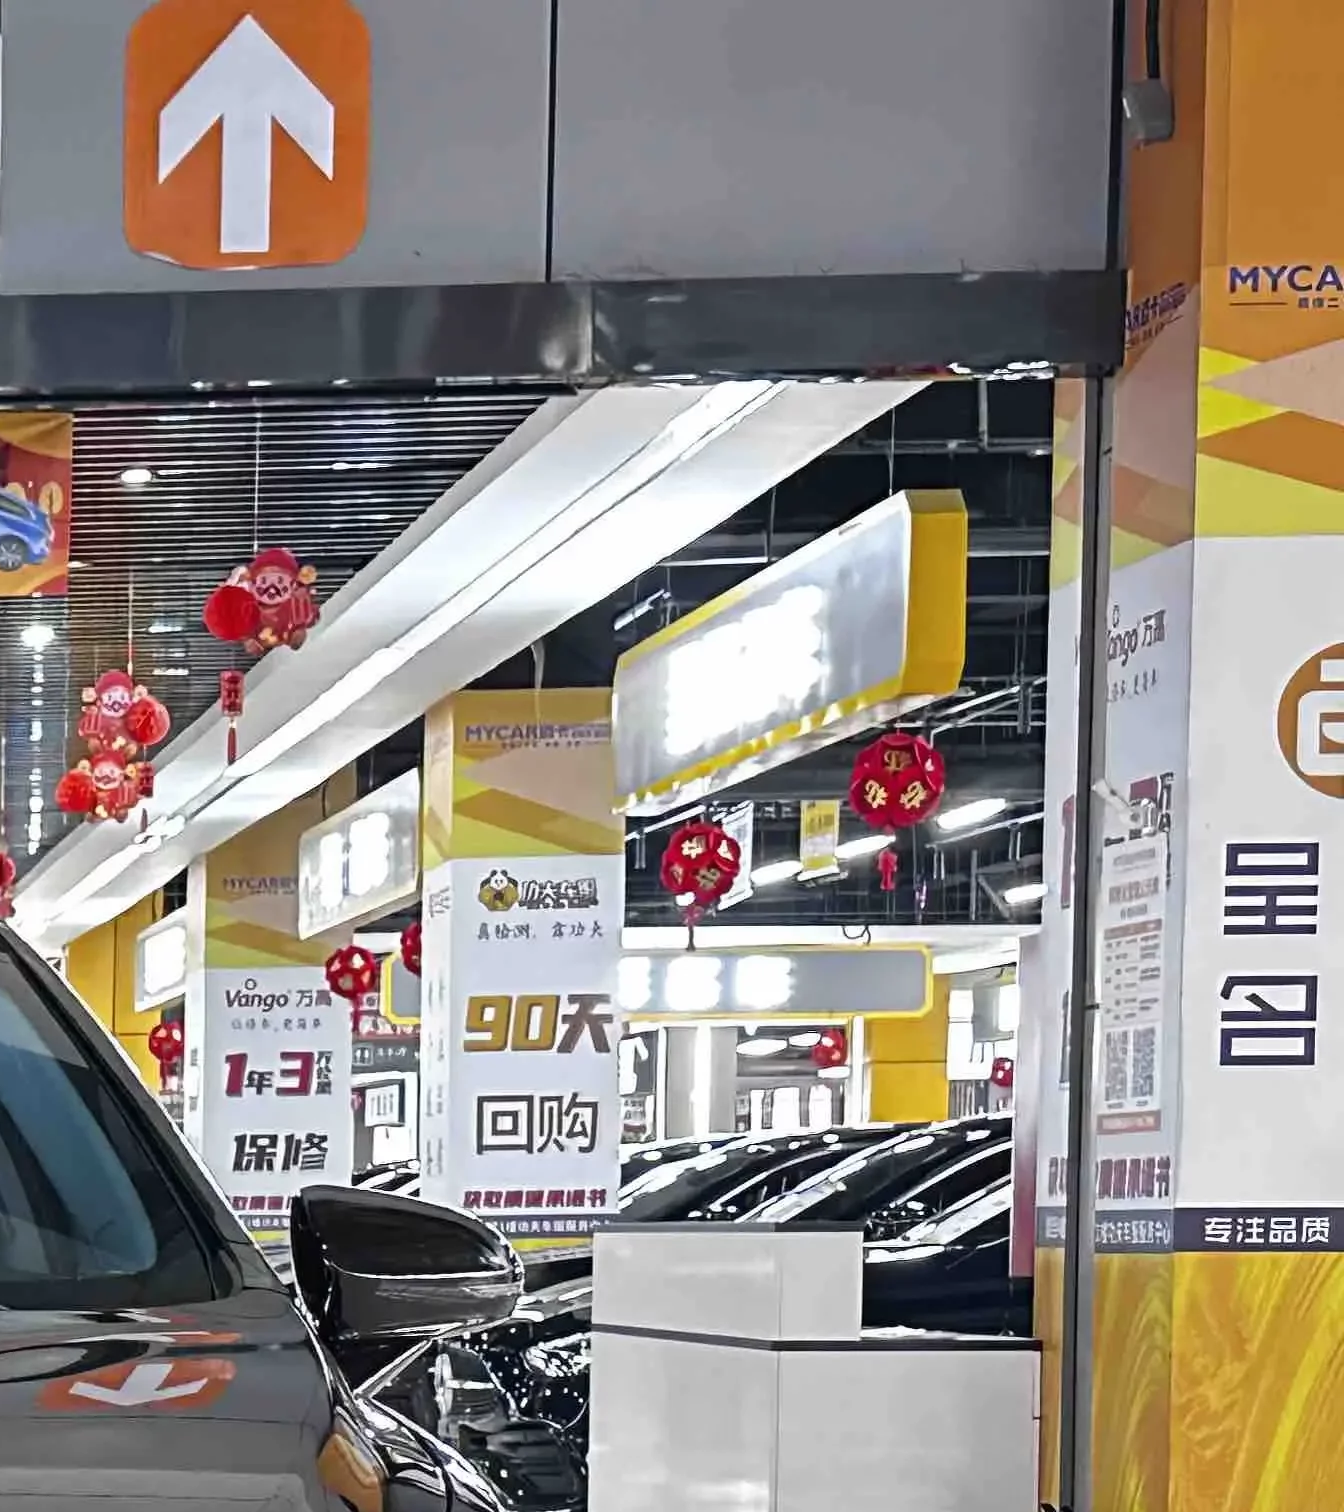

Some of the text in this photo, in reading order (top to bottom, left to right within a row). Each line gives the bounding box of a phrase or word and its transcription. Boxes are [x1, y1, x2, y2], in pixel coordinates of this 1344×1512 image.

[1229, 265, 1344, 293] MYCA
[225, 986, 289, 1012] Vango
[463, 993, 614, 1054] 90天
[476, 1091, 600, 1156] 回购
[232, 1132, 329, 1173] 保修
[1204, 1216, 1330, 1244] 专注品质
